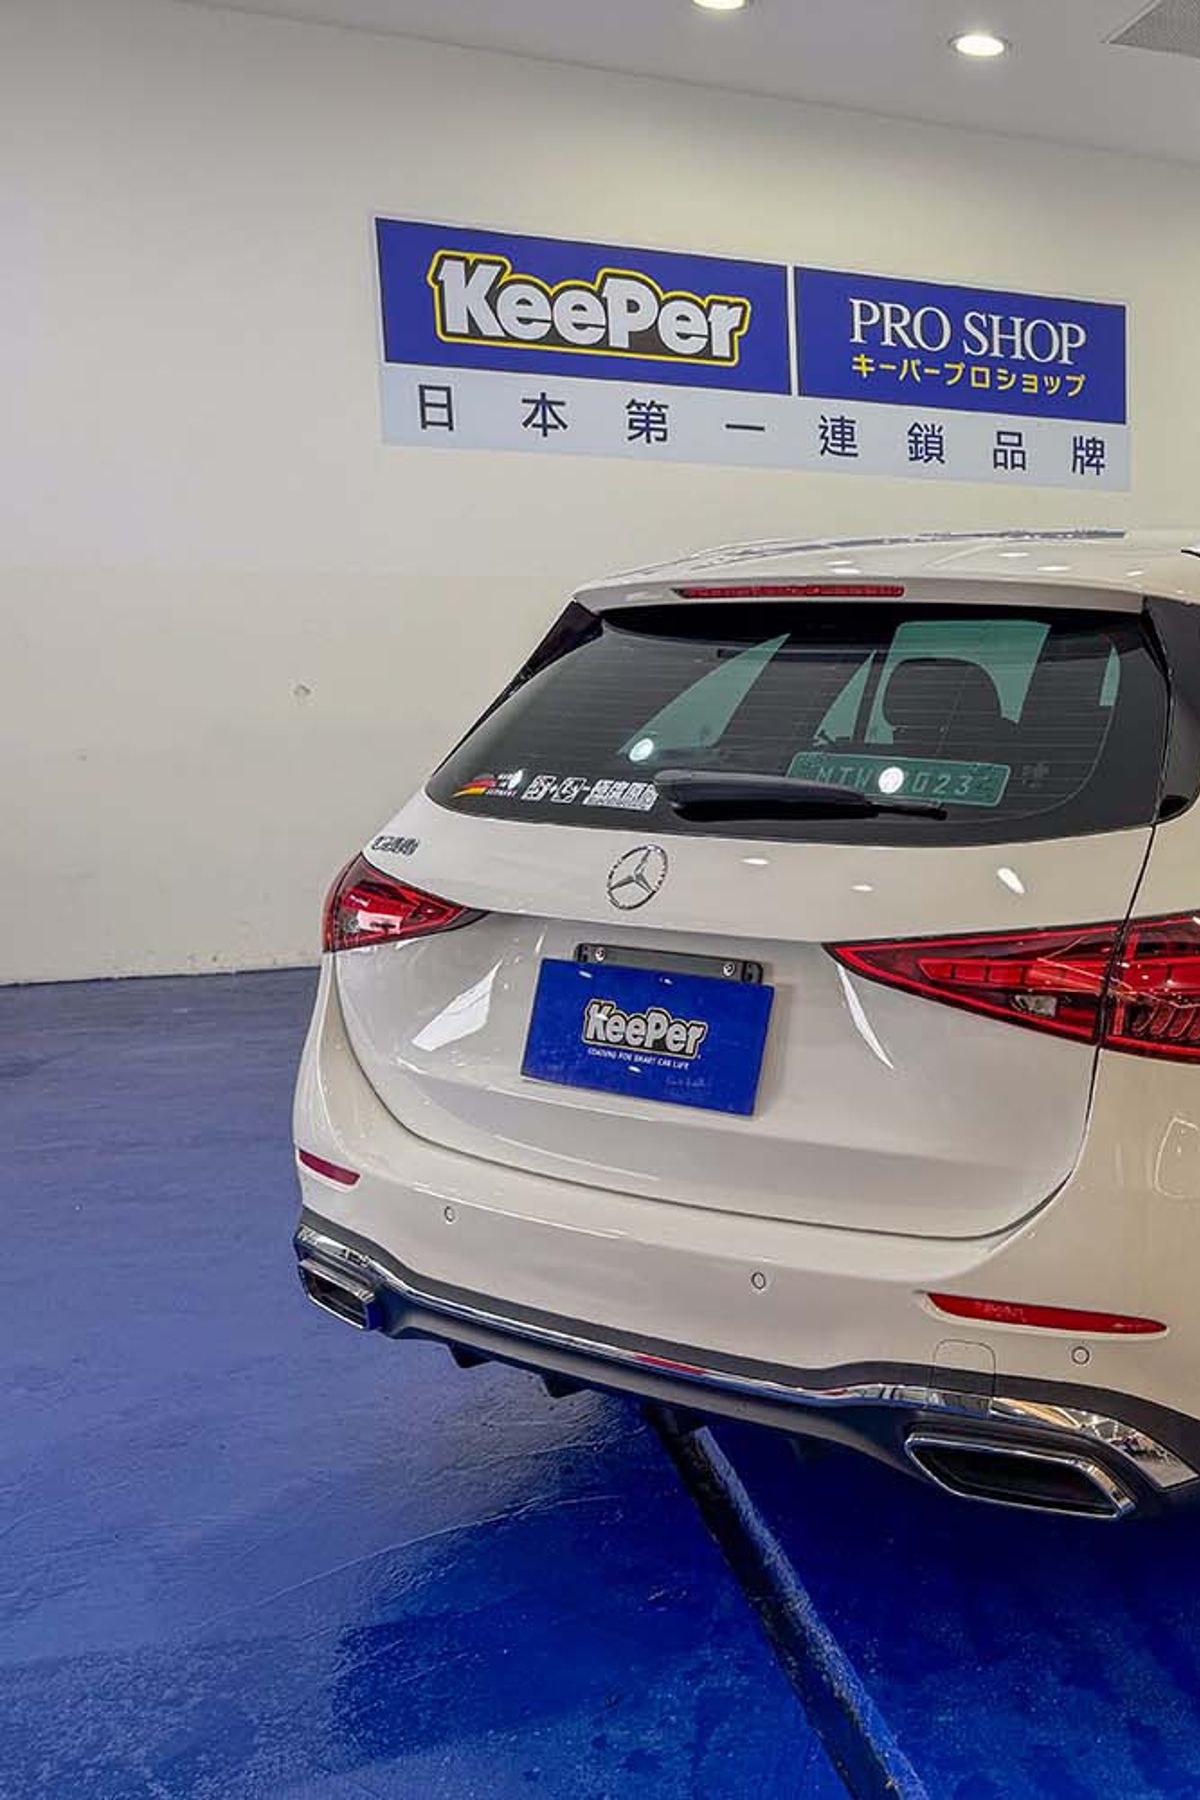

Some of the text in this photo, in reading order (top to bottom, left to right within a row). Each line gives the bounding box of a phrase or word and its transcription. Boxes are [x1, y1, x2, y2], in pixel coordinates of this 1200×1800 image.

[436, 257, 744, 359] KeePer
[848, 297, 1087, 366] PRO SHOP
[851, 352, 1087, 398] キーパープロショップ
[417, 384, 1107, 478] 日本第一連鎖品牌
[583, 1000, 706, 1056] KeePer
